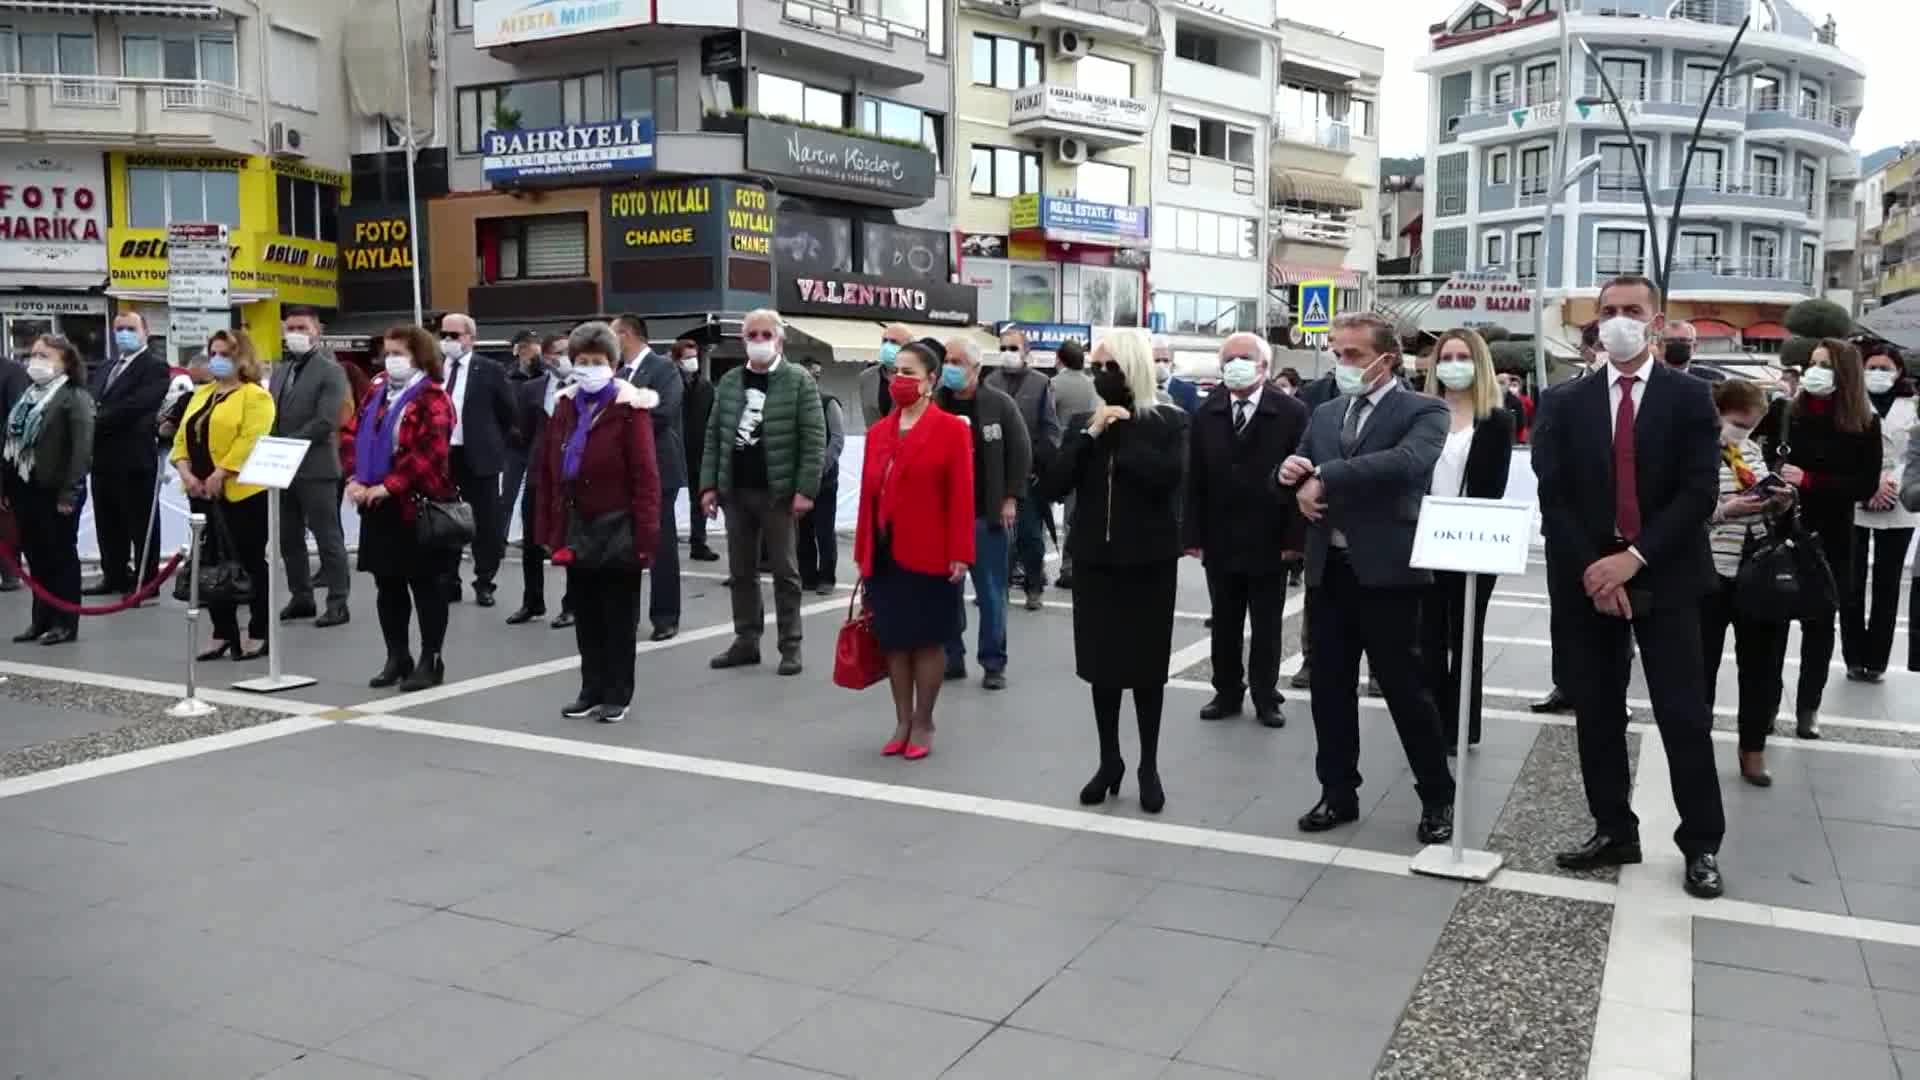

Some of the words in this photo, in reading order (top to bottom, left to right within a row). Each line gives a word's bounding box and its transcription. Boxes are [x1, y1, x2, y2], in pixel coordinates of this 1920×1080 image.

[491, 119, 641, 155] BAHRİYELİ
[199, 157, 249, 170] OFFICE
[0, 184, 94, 211] FOTO
[611, 191, 647, 217] FOTO
[651, 187, 710, 215] YAYLALI
[735, 189, 765, 209] FOTO
[1050, 200, 1073, 214] REAL
[1075, 203, 1107, 218] ESTATE
[355, 219, 407, 243] FOTO
[728, 210, 773, 233] YAYLALI
[625, 227, 693, 246] CHANGE
[734, 234, 769, 254] CHANGE
[344, 246, 413, 270] YAYLAL
[797, 278, 926, 310] VALENTINO
[1437, 295, 1476, 309] GRAND
[1486, 296, 1530, 312] BAZAAR
[1433, 529, 1511, 544] OKULLAR
